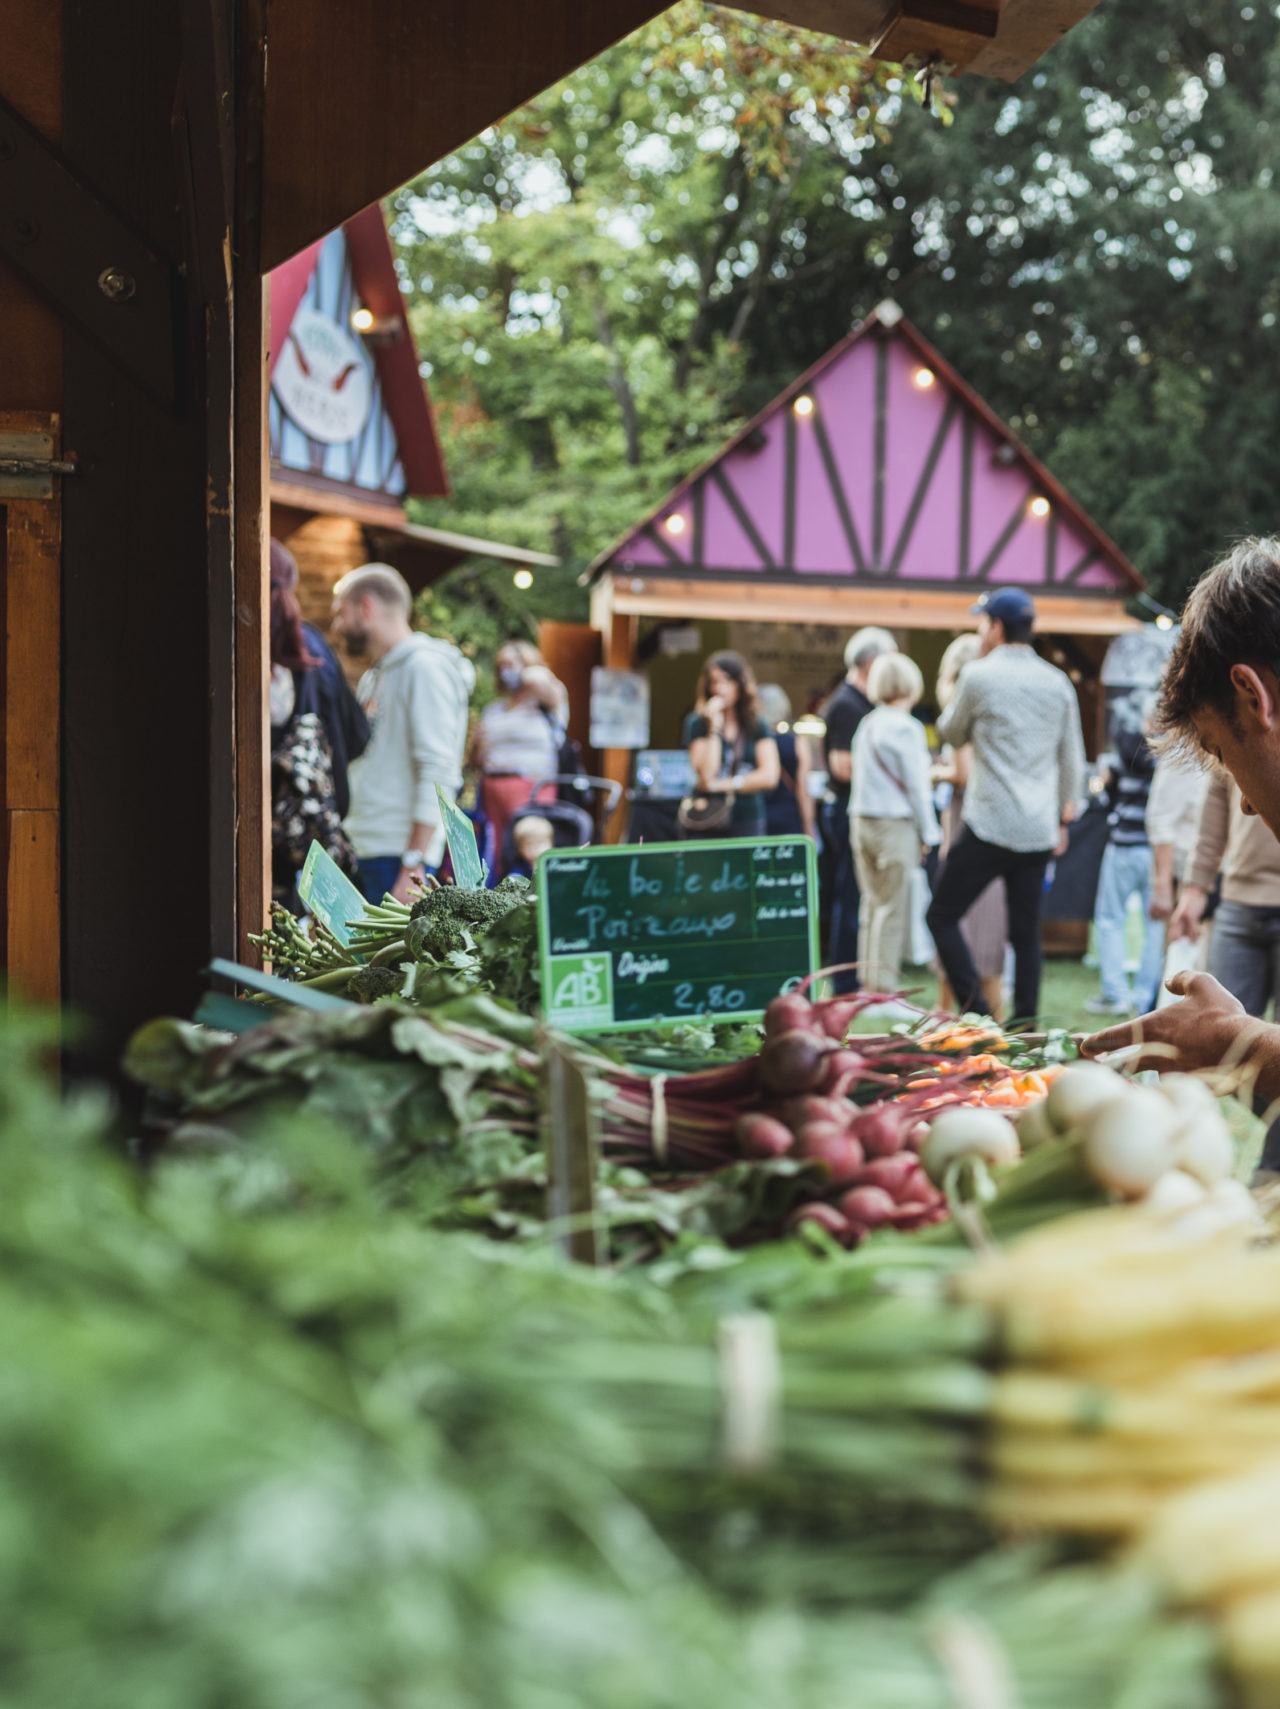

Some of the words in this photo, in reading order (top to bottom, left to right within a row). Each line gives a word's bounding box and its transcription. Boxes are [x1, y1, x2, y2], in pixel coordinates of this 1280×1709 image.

[617, 951, 670, 984] Origine
[554, 971, 602, 1008] AB
[673, 982, 746, 1014] 2,80
